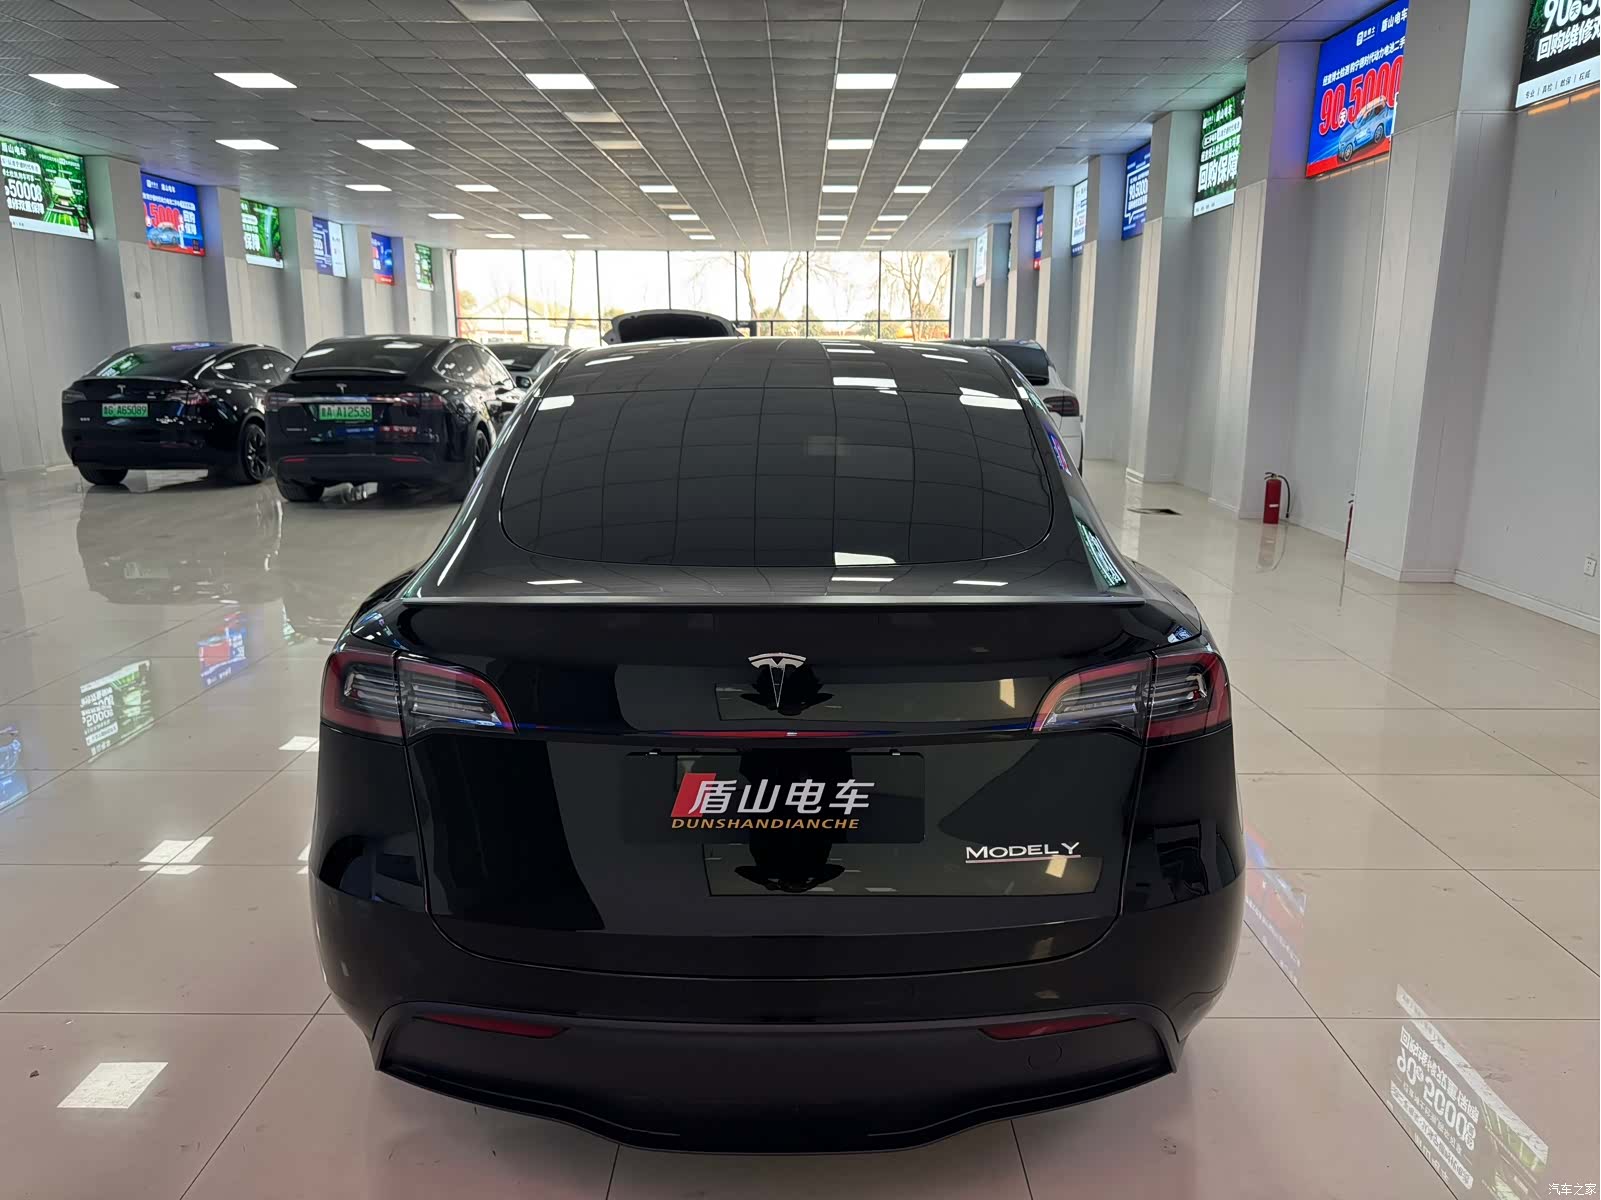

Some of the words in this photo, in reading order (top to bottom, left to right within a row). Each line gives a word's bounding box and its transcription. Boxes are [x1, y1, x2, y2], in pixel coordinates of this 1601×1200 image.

[1381, 8, 1408, 32] 盾山电车
[1198, 150, 1239, 192] 回购保障
[688, 778, 875, 815] 盾山电车
[671, 818, 860, 829] DUNSHANDIANCHE
[966, 844, 1059, 859] MODEL
[1061, 842, 1080, 855] Y
